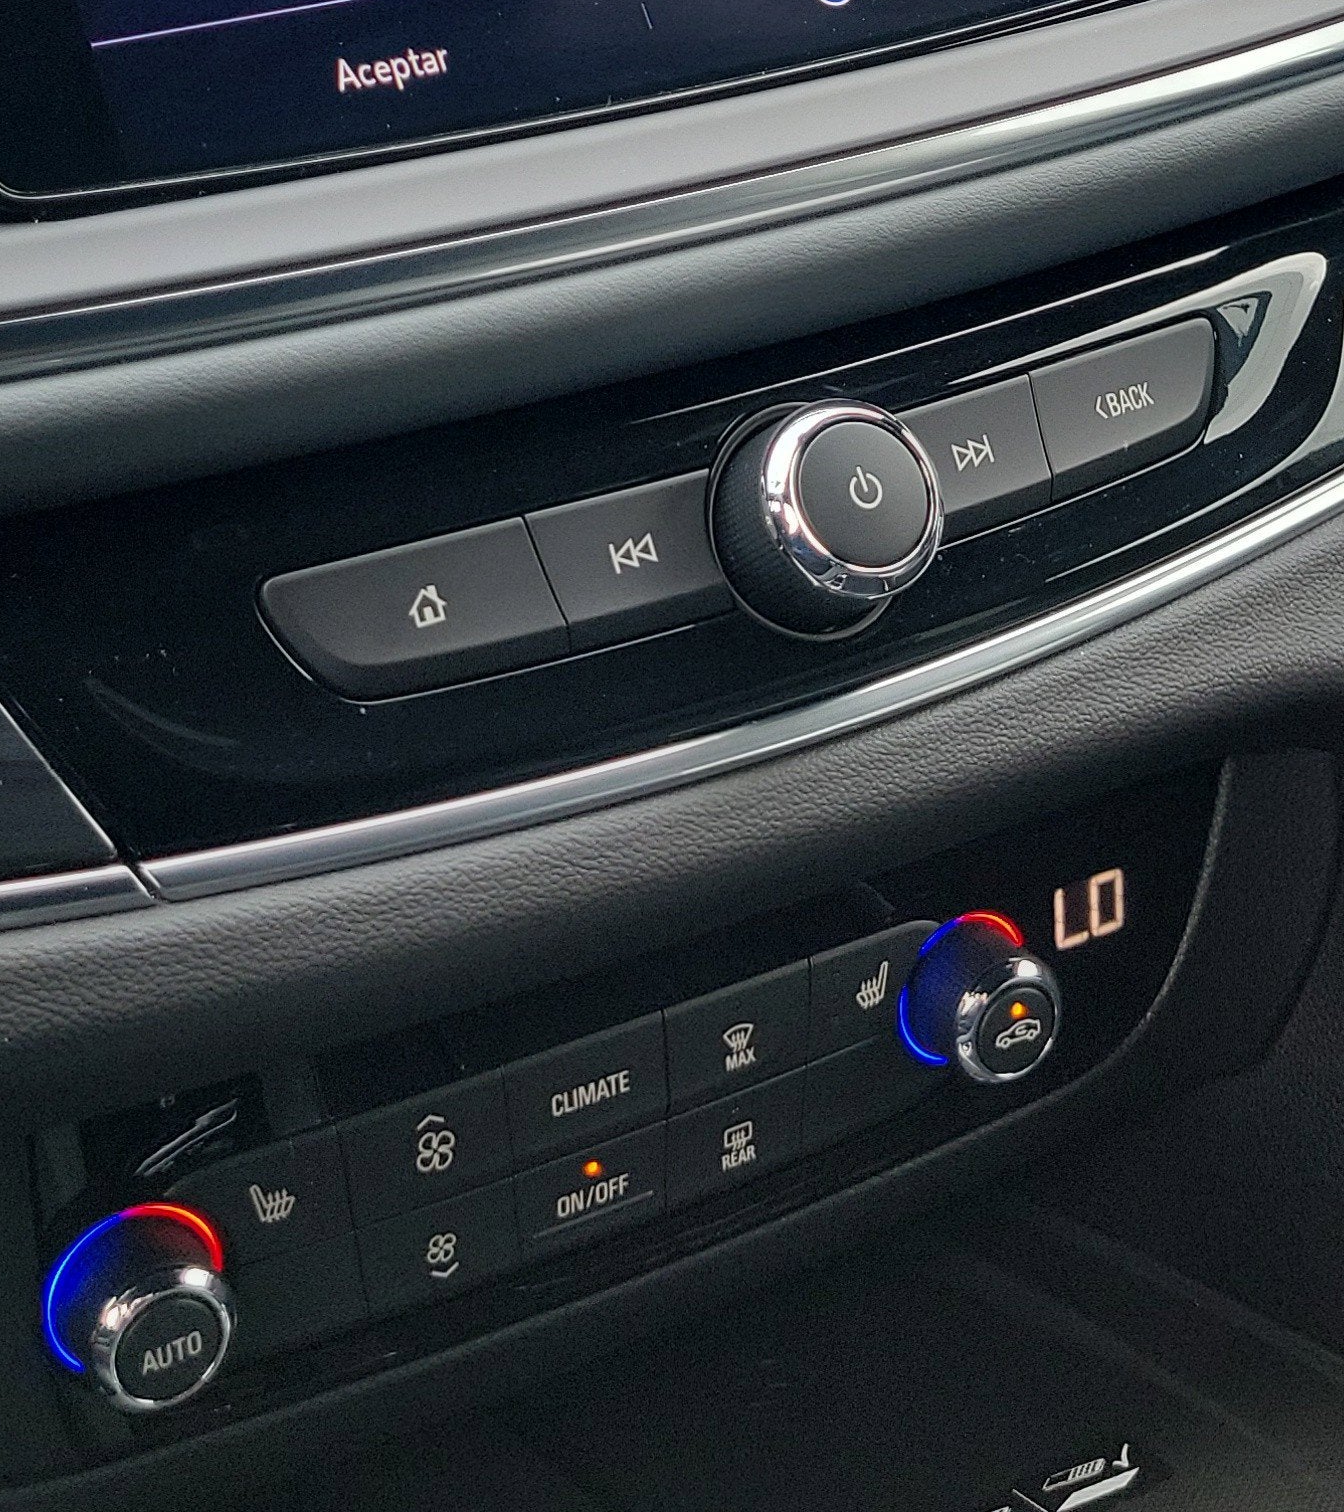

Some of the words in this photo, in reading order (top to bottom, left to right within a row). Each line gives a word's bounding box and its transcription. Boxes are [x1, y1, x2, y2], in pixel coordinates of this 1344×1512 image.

[335, 45, 448, 93] Aceptar
[725, 1046, 756, 1072] MAX
[551, 1069, 630, 1117] CLIMATE
[721, 1144, 756, 1172] REAR
[557, 1172, 629, 1218] ON/OFF
[142, 1329, 203, 1376] AUTO
